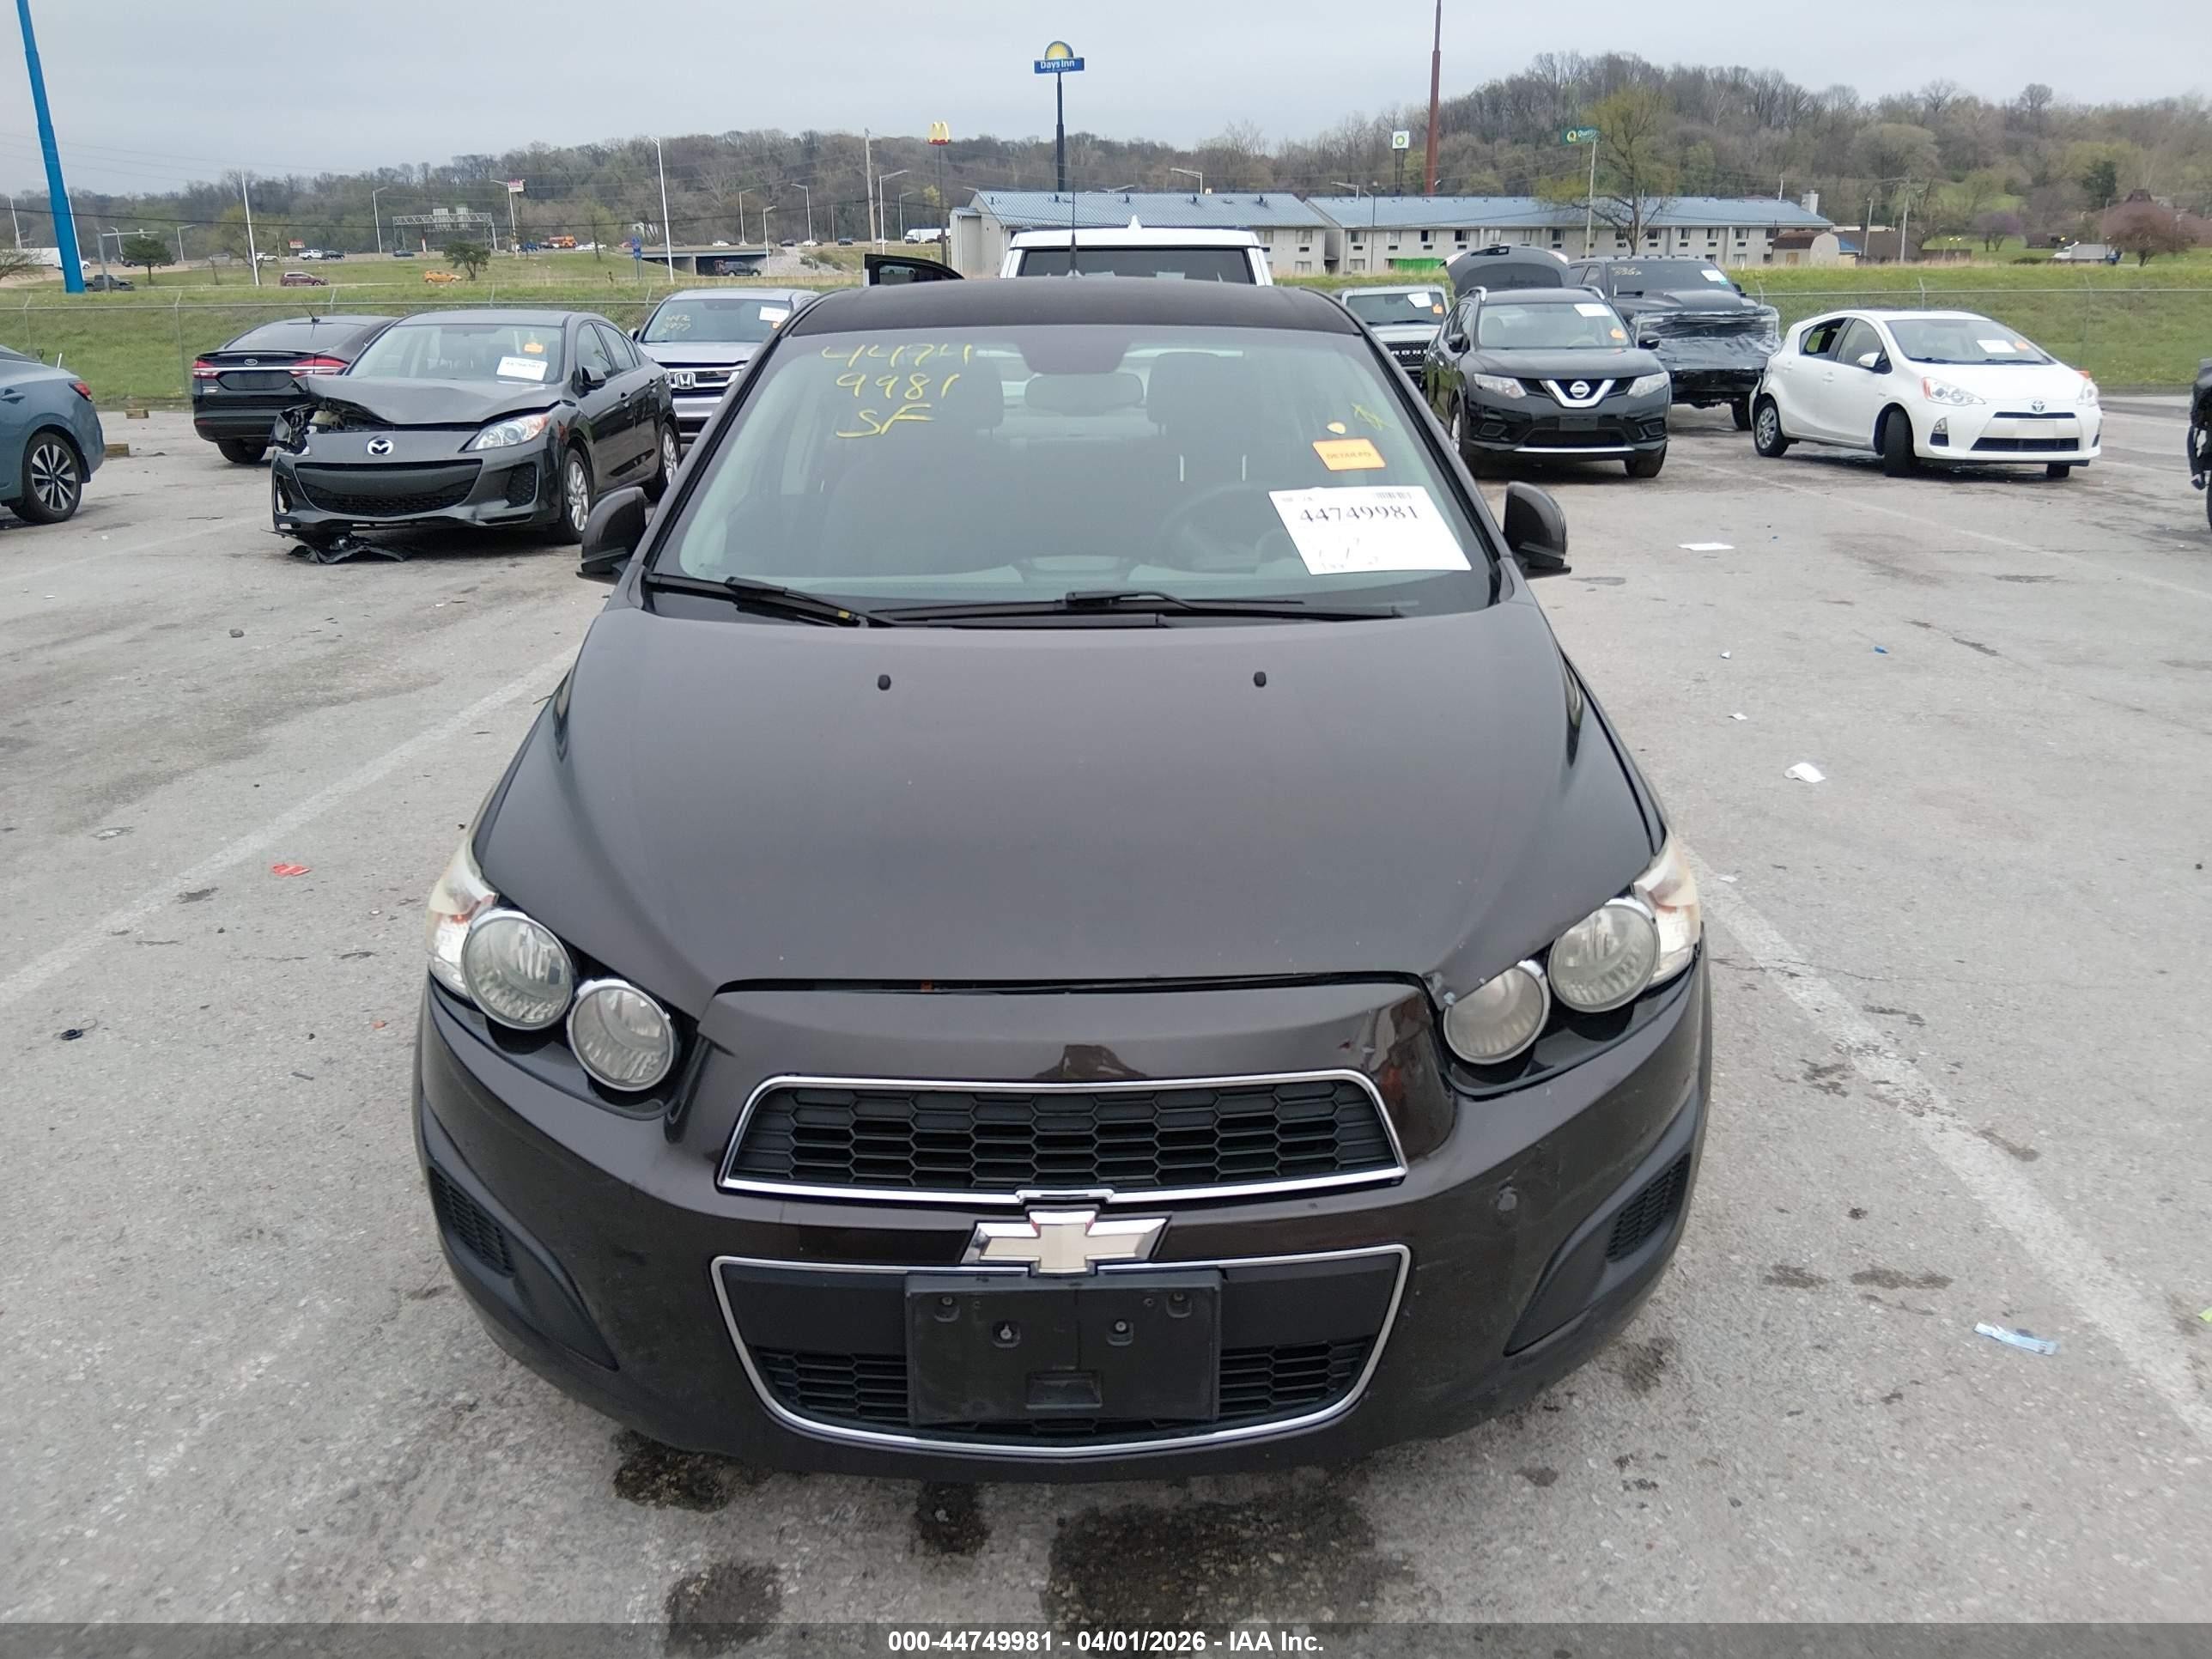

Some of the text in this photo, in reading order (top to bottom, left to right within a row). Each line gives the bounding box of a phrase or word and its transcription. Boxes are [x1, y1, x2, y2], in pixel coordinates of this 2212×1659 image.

[1040, 59, 1075, 70] Days Inn
[836, 372, 961, 400] 9981
[836, 403, 935, 438] SF
[1299, 505, 1419, 522] 44749981
